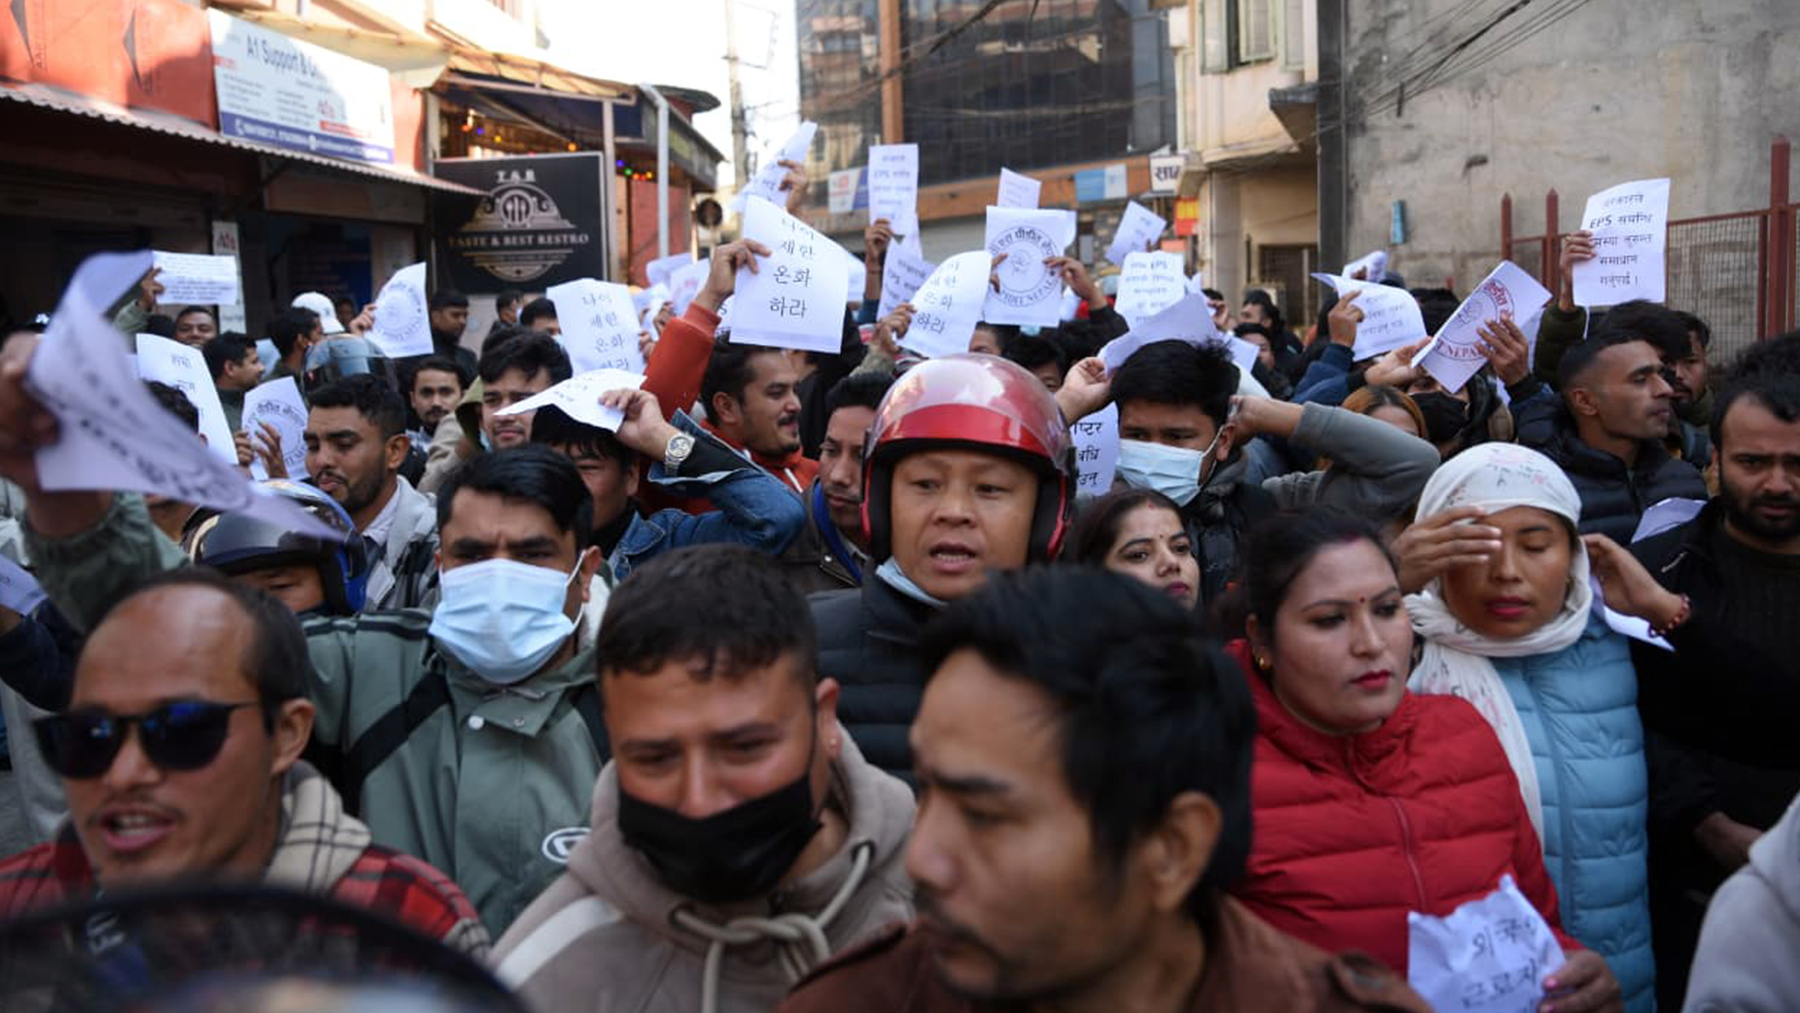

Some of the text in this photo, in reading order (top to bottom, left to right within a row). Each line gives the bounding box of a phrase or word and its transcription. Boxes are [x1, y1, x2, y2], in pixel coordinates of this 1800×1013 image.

[261, 39, 300, 75] Support
[1590, 214, 1612, 229] EPS
[491, 236, 500, 247] &
[503, 235, 533, 246] BEST
[537, 233, 589, 245] RESTRO
[769, 296, 808, 318] 하라
